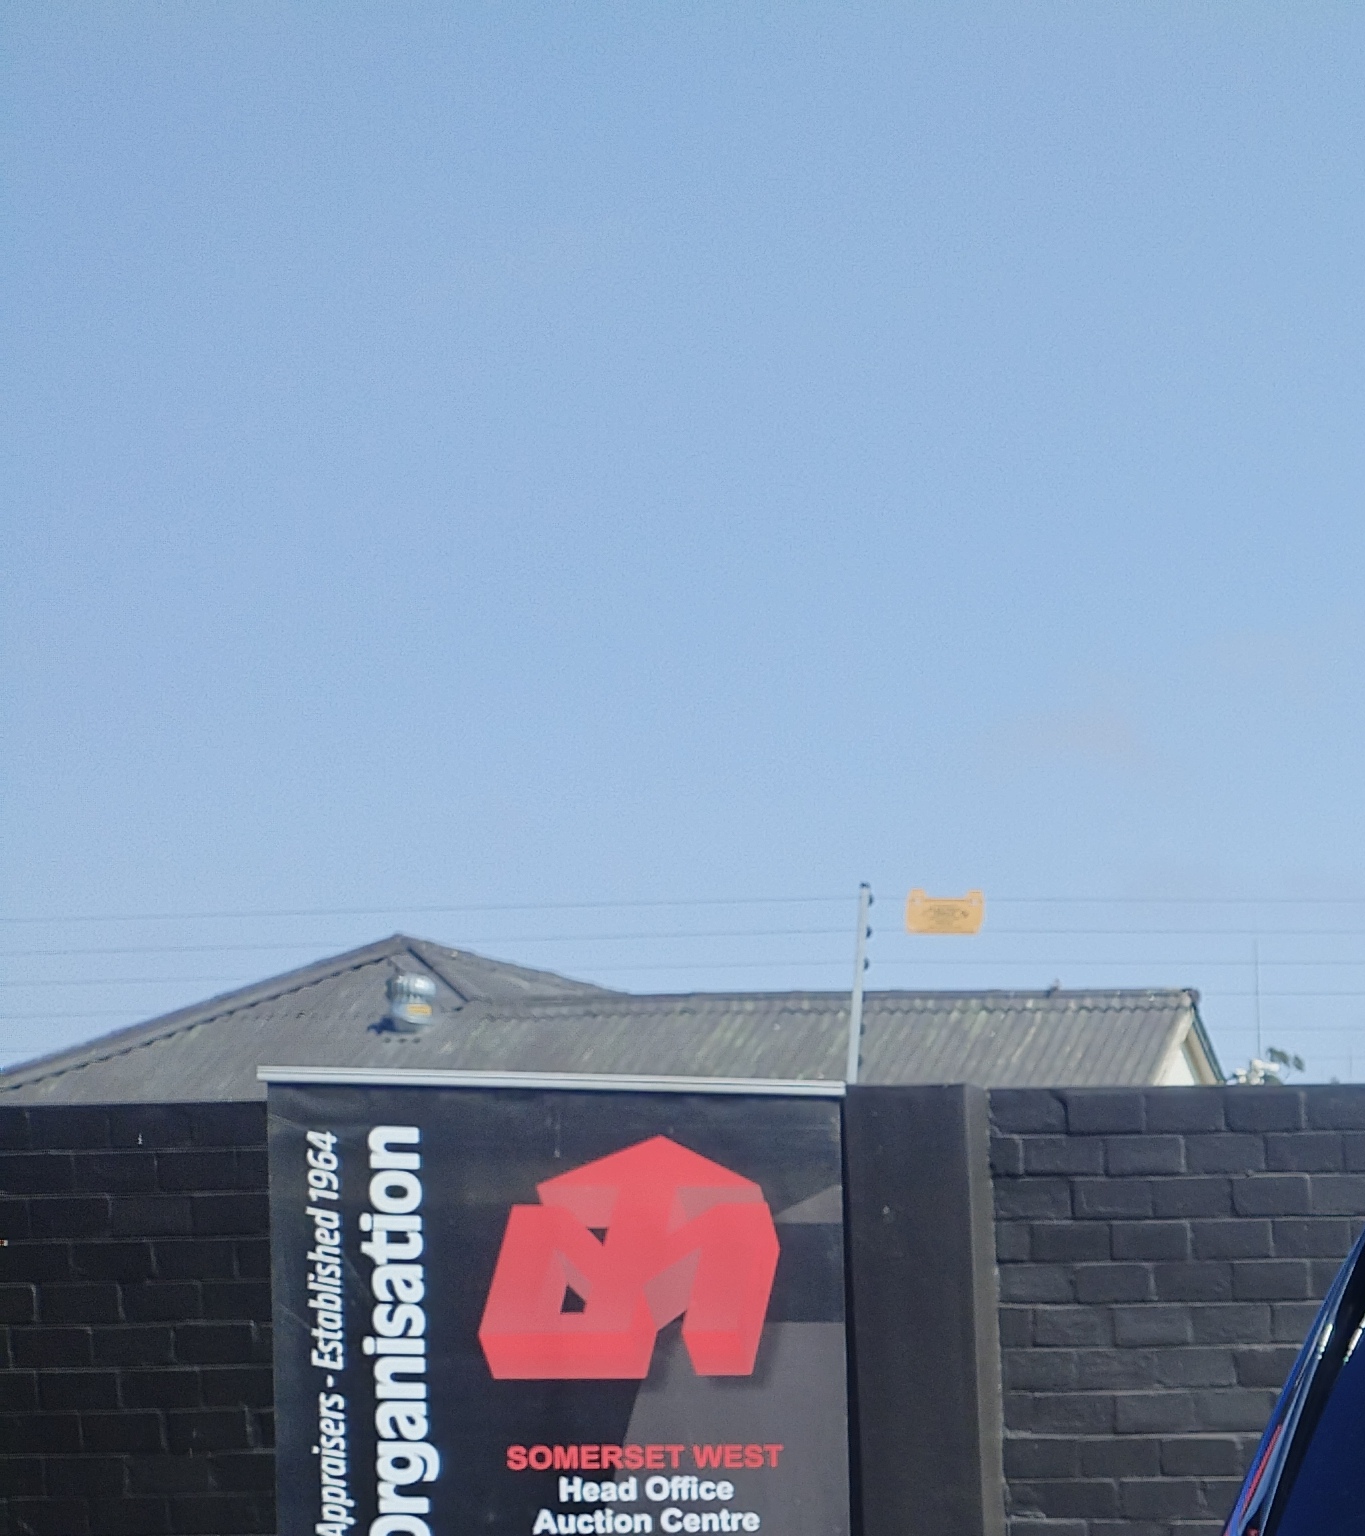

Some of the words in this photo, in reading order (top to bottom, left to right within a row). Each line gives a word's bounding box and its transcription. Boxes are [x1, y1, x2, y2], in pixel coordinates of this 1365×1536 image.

[306, 1130, 340, 1202] 1964
[305, 1206, 344, 1371] Established
[506, 1444, 685, 1471] SOMERSET
[692, 1443, 784, 1469] WEST
[559, 1475, 638, 1503] Head
[644, 1475, 735, 1502] Office
[532, 1507, 653, 1535] Auction
[660, 1507, 761, 1533] Centre
